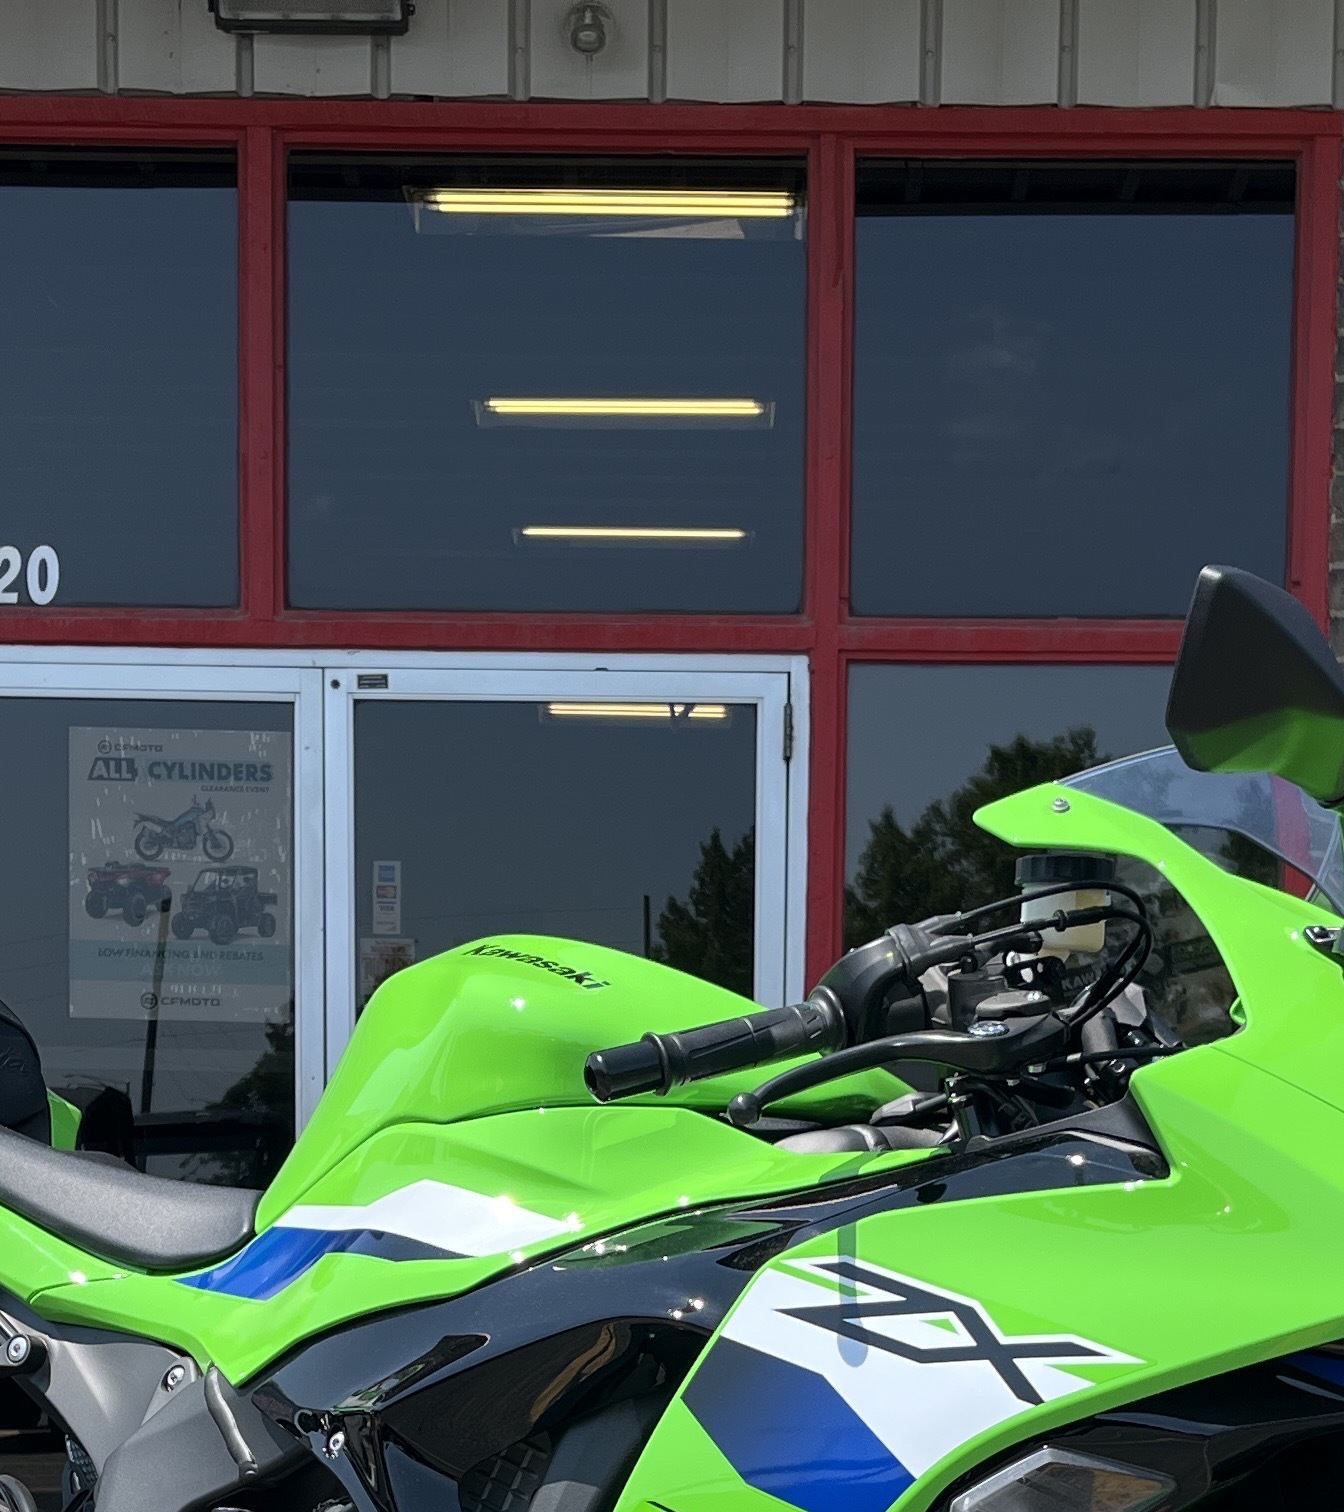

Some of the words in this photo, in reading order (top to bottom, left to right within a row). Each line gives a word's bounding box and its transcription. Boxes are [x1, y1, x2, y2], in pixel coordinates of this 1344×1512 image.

[90, 758, 136, 780] ALL
[148, 761, 273, 781] CYLINDERS
[461, 944, 612, 990] Kawasaki
[161, 997, 220, 1006] CFMOTO
[771, 1255, 1112, 1406] ZX
